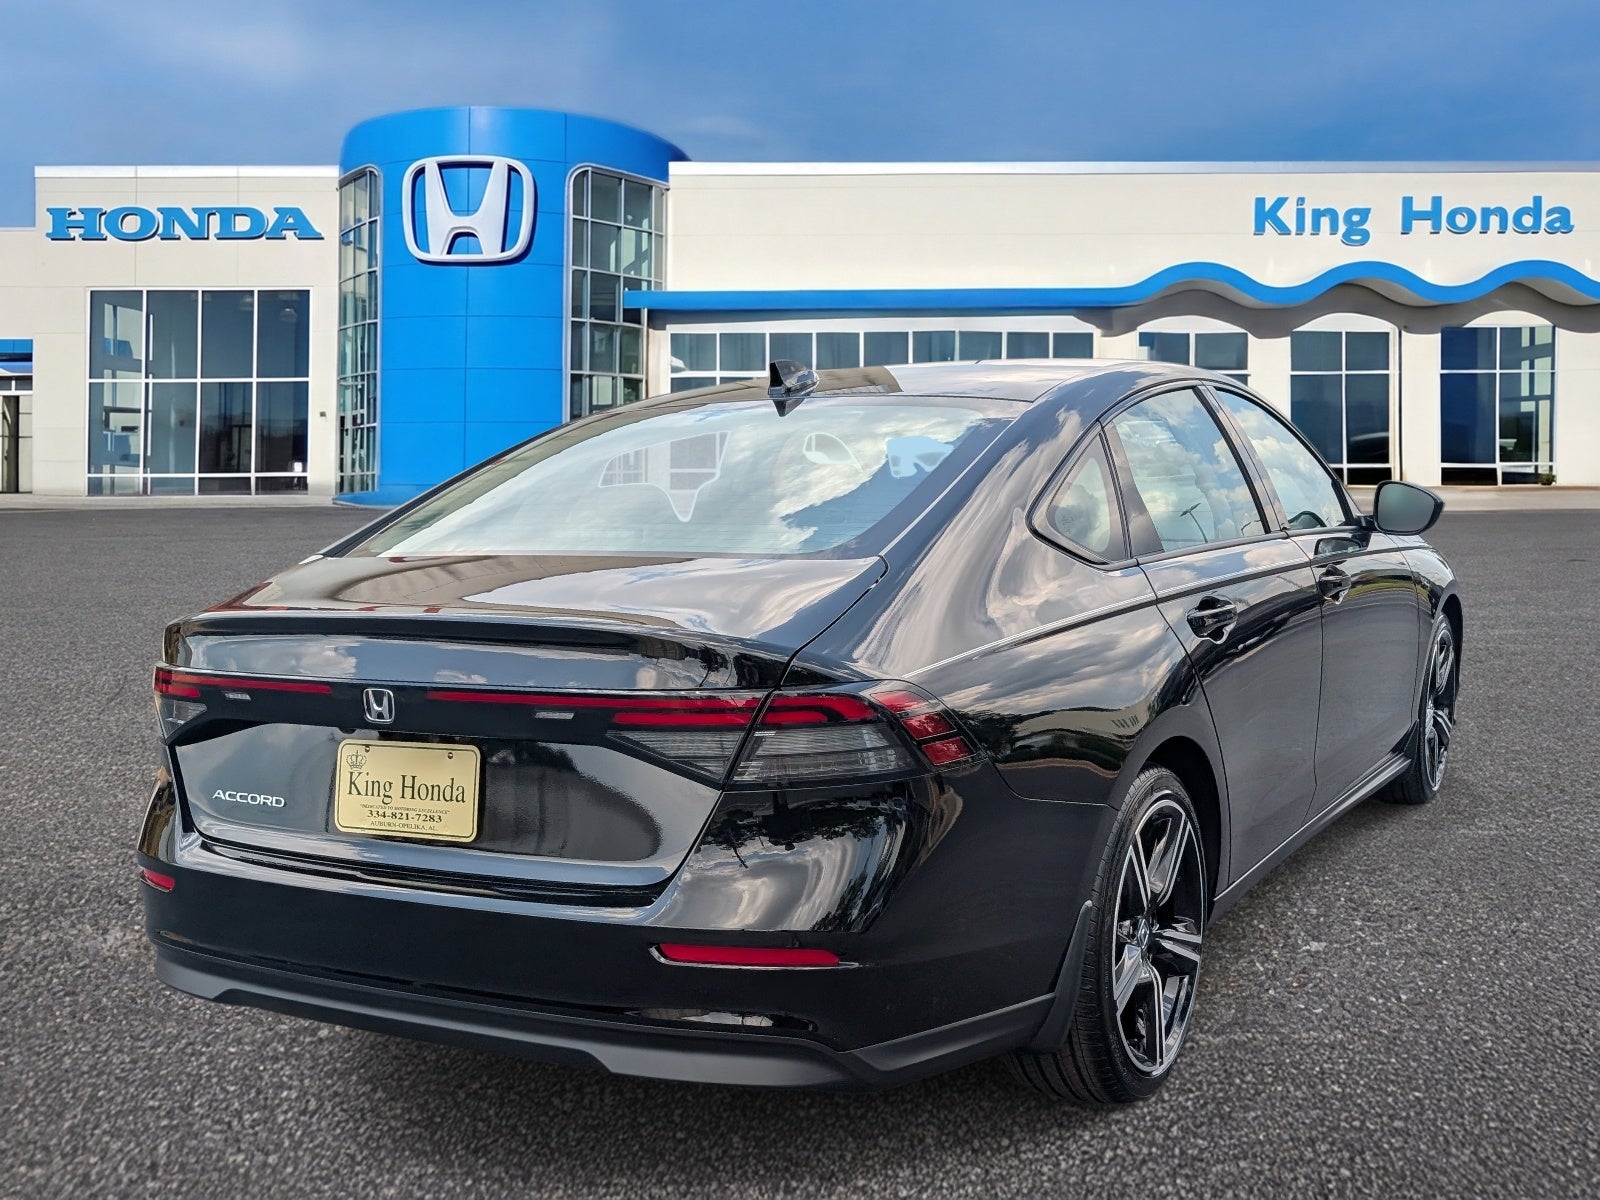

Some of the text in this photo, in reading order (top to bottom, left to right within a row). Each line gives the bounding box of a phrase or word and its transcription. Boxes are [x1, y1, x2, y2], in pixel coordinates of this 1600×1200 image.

[45, 206, 325, 241] HONDA
[1253, 195, 1575, 247] King Honda
[212, 789, 285, 807] ACCORD
[347, 771, 466, 805] King Honda
[367, 809, 442, 823] 334-821-7283
